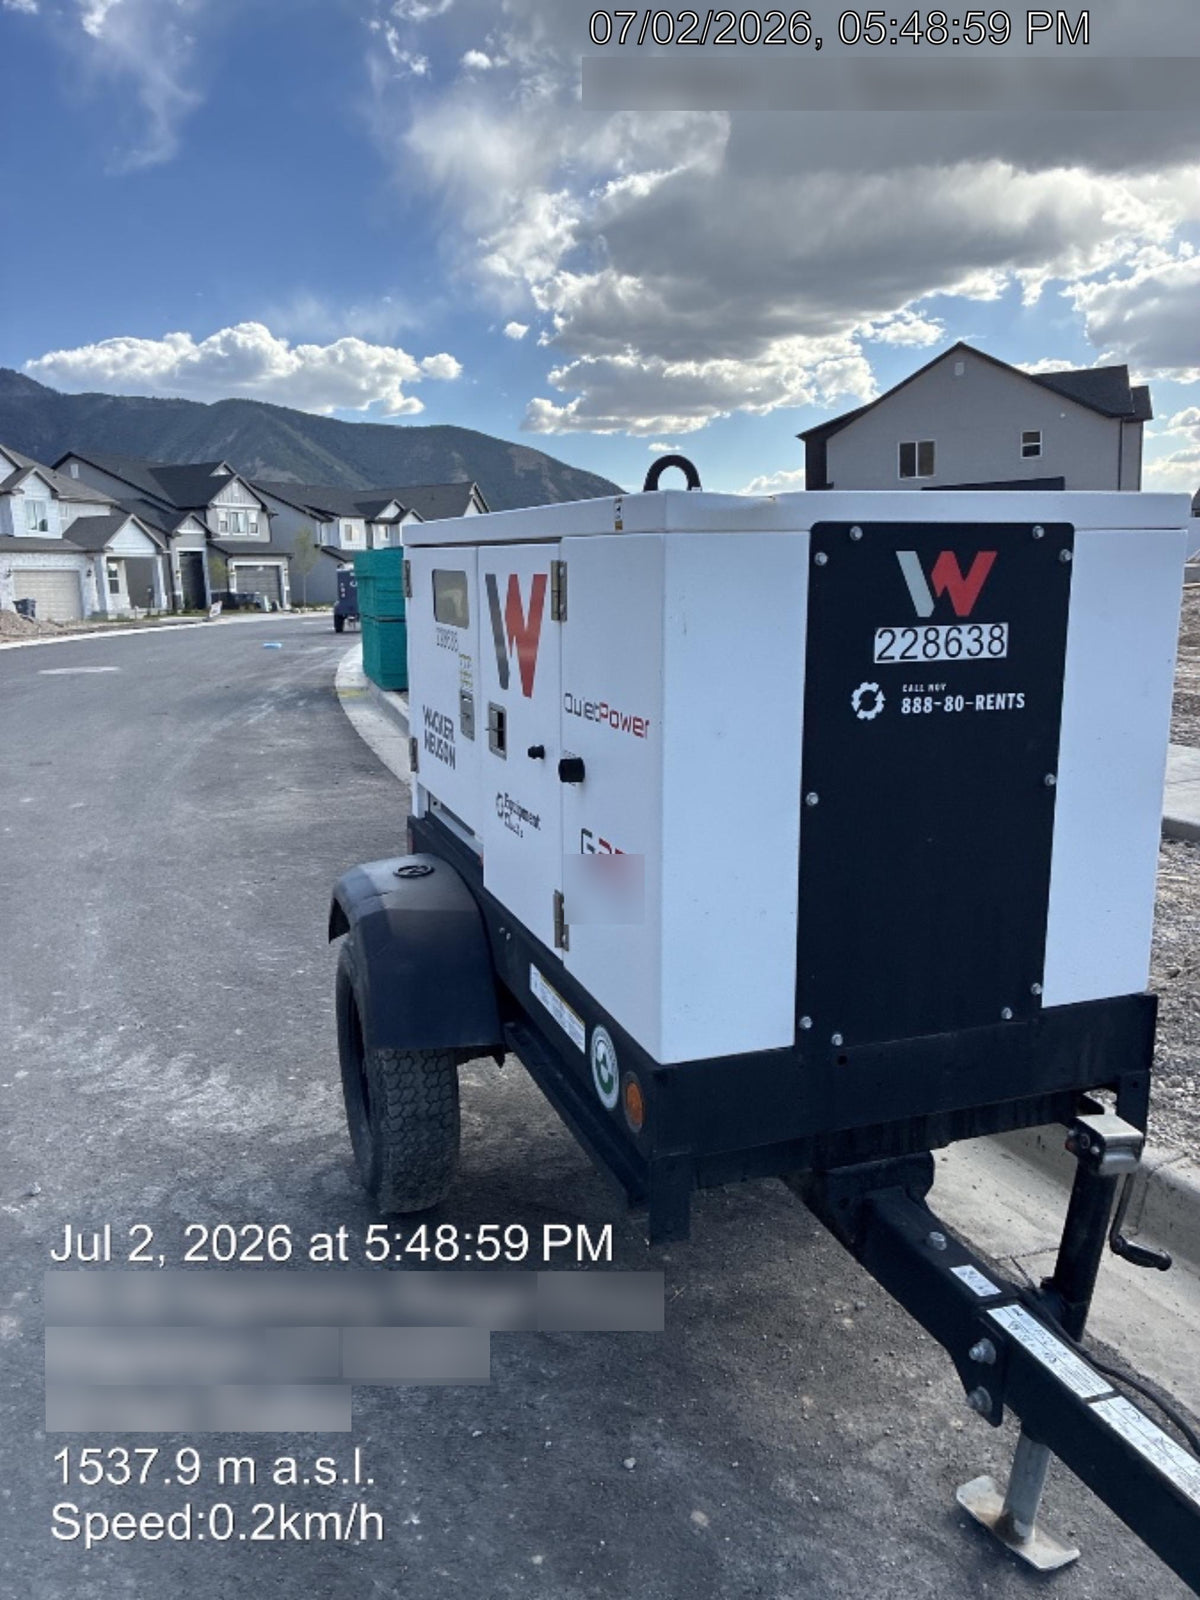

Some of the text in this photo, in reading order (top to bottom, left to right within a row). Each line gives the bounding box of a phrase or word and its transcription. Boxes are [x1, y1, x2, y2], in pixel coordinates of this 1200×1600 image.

[876, 624, 1005, 661] 228638
[902, 684, 925, 693] CALL
[564, 692, 650, 738] QuietPower
[901, 693, 1026, 714] 888-80-RENTS
